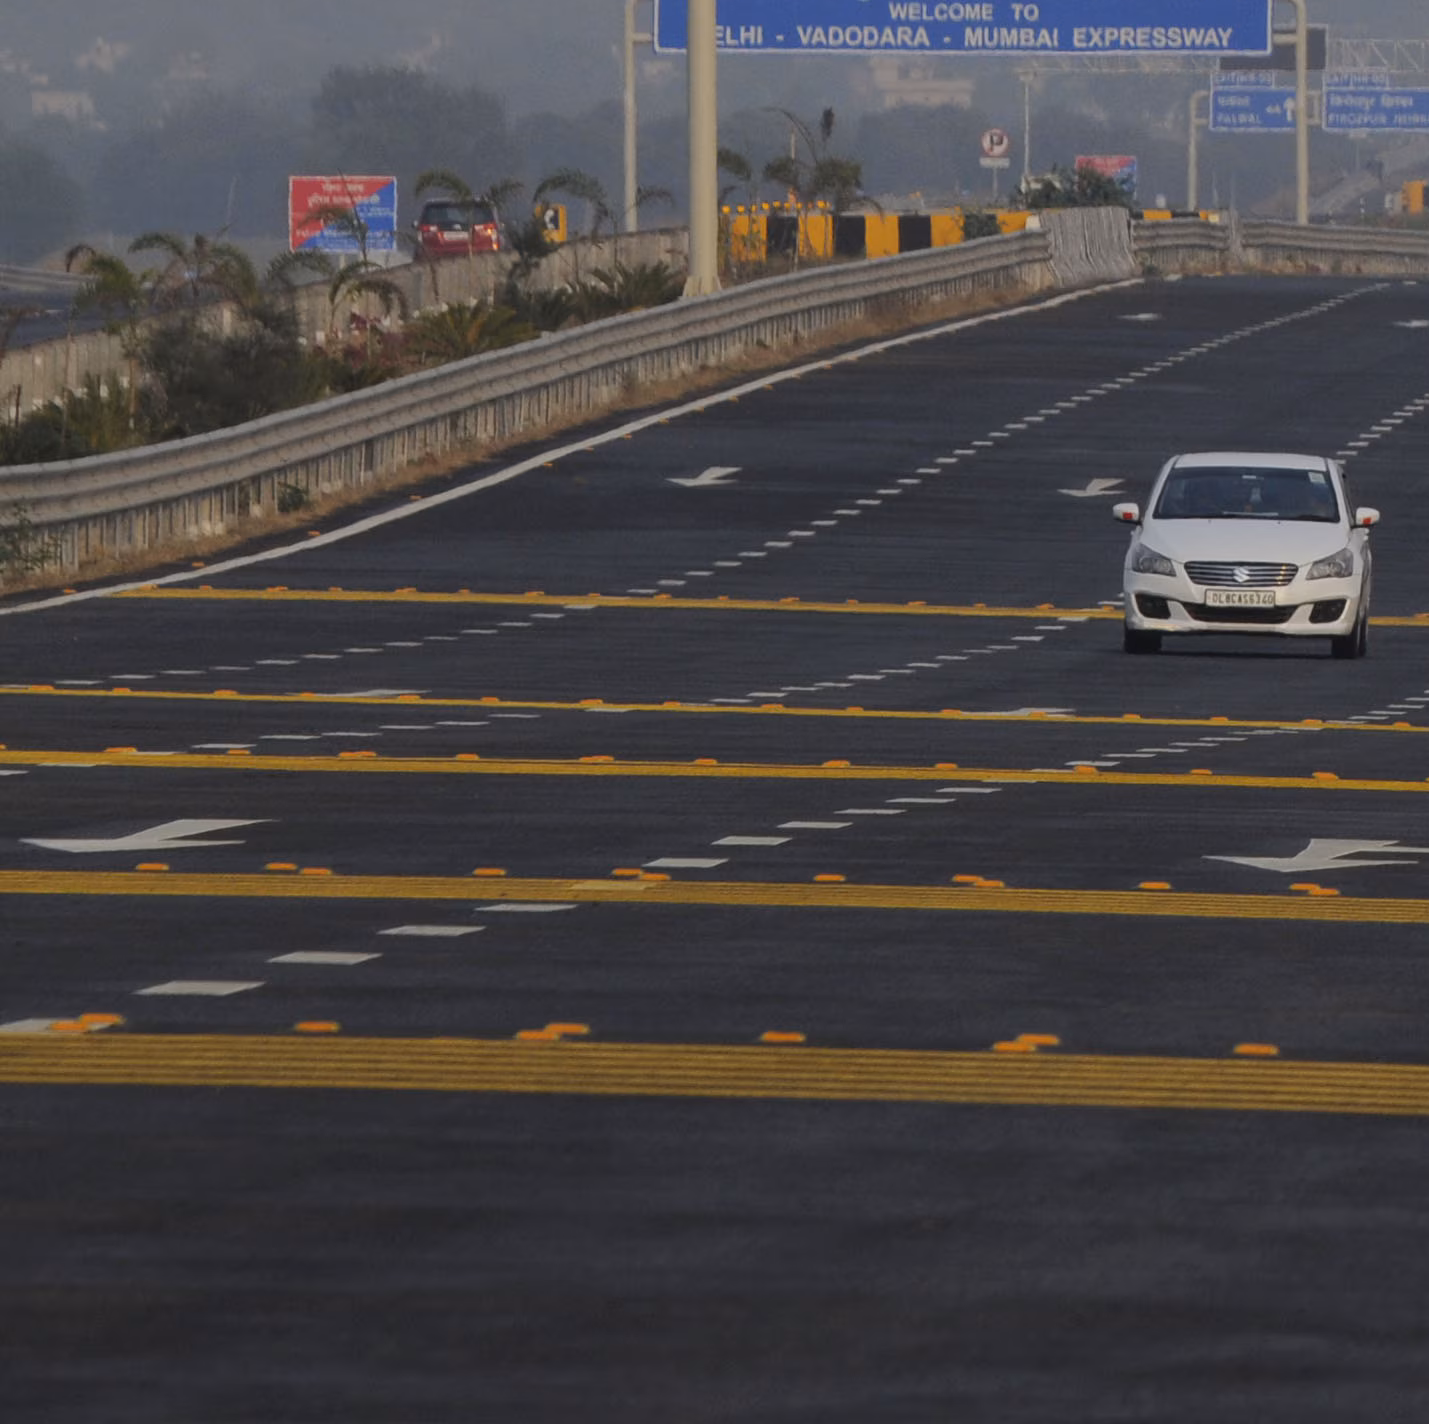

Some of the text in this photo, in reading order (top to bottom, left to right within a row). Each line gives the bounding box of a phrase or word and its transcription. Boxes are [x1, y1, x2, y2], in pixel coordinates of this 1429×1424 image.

[889, 2, 1039, 22] WELCOME TO
[716, 25, 763, 45] ELHI
[797, 25, 930, 46] VADODARA
[965, 27, 1059, 47] MUMBAI
[1073, 27, 1232, 48] EXPRESSWAY
